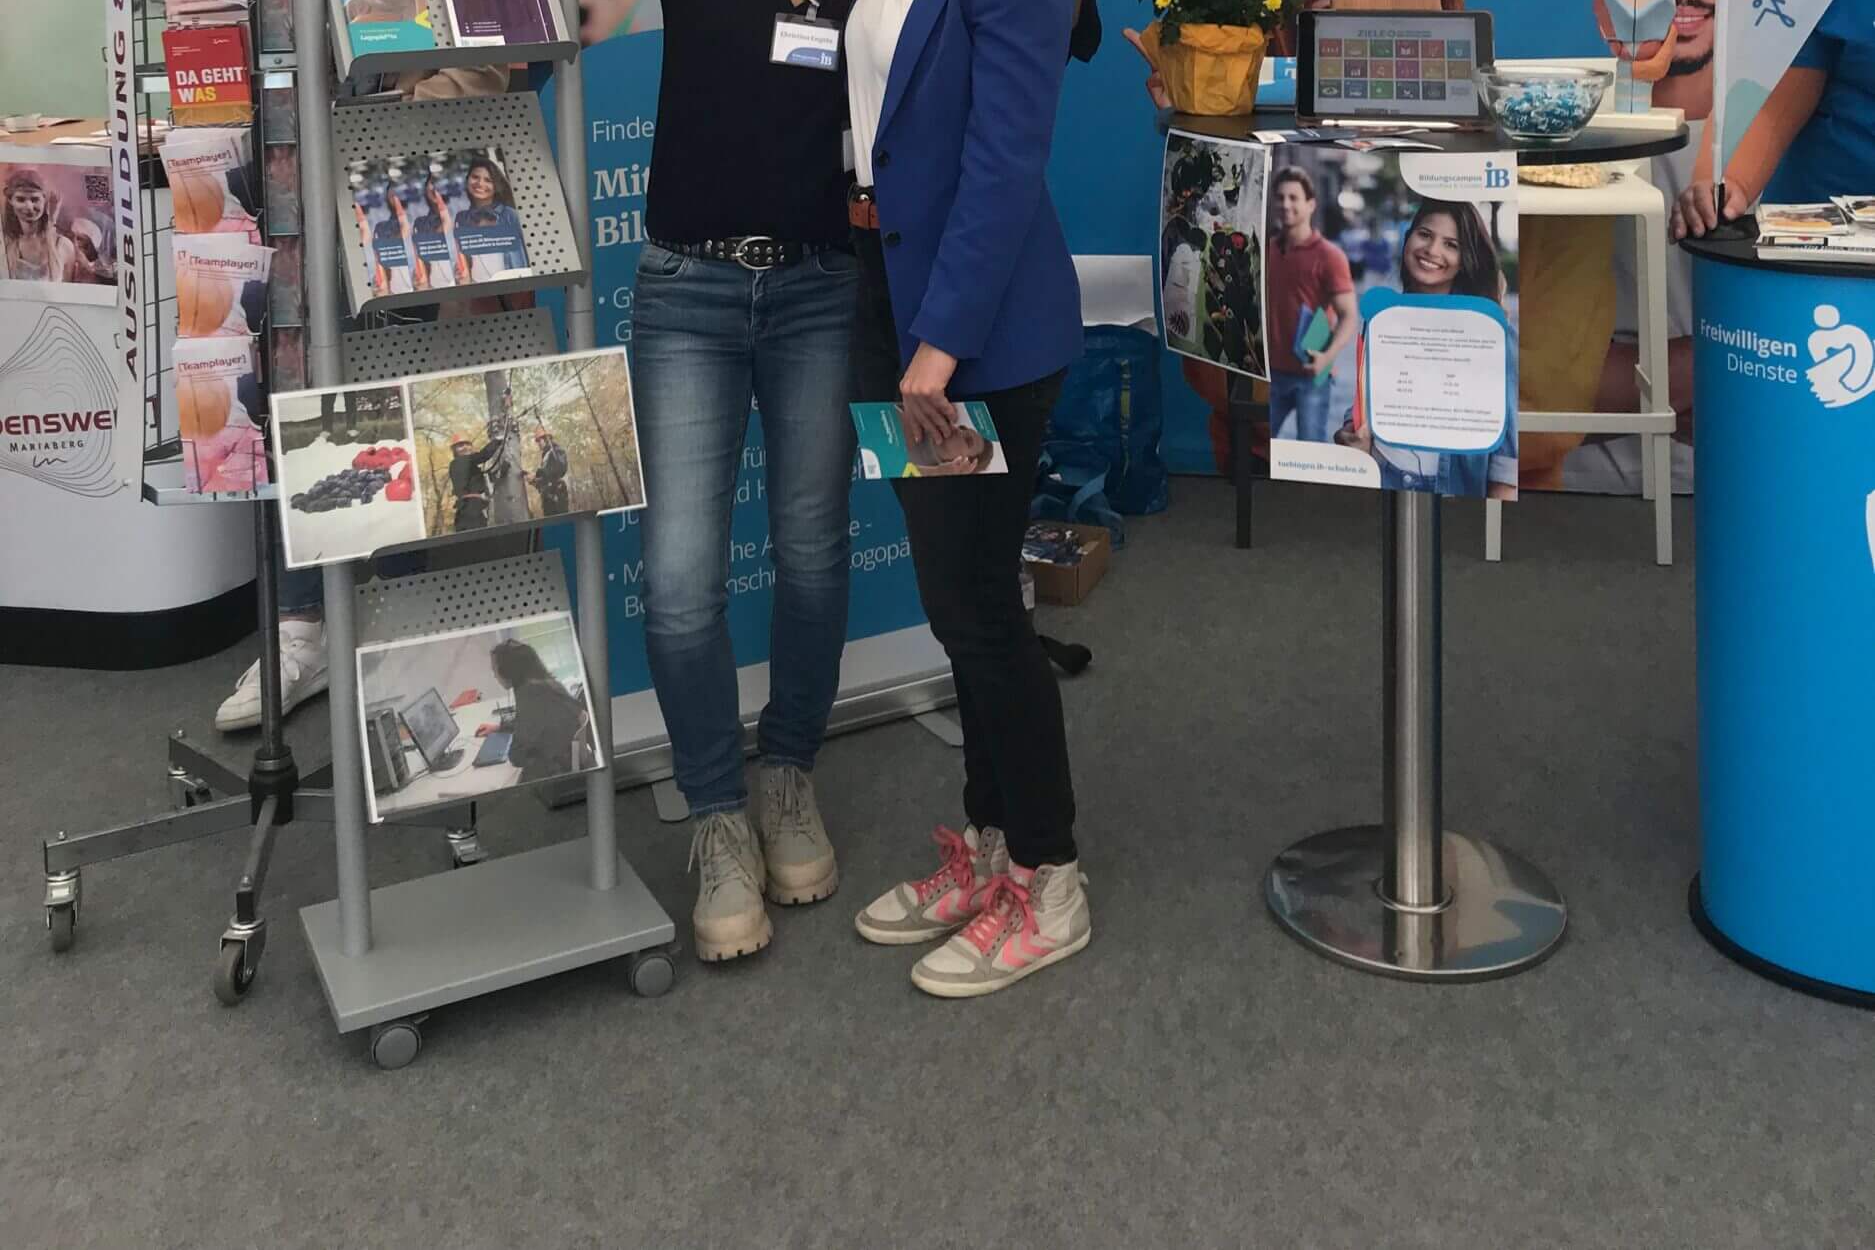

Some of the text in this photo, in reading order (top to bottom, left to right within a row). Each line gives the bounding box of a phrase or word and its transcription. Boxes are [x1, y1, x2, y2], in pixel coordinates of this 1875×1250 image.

[175, 66, 244, 86] DA GEHT
[178, 86, 217, 103] WAS
[592, 116, 655, 143] Finde
[167, 150, 232, 168] [Teamplayer]
[113, 30, 138, 382] AUSBILDUNG
[189, 255, 259, 270] [Teamplayer]
[1700, 317, 1798, 359] Freiwilligen
[178, 354, 247, 373] [Teamplayer]
[1727, 353, 1798, 384] Dienste
[850, 536, 912, 573] ogopä
